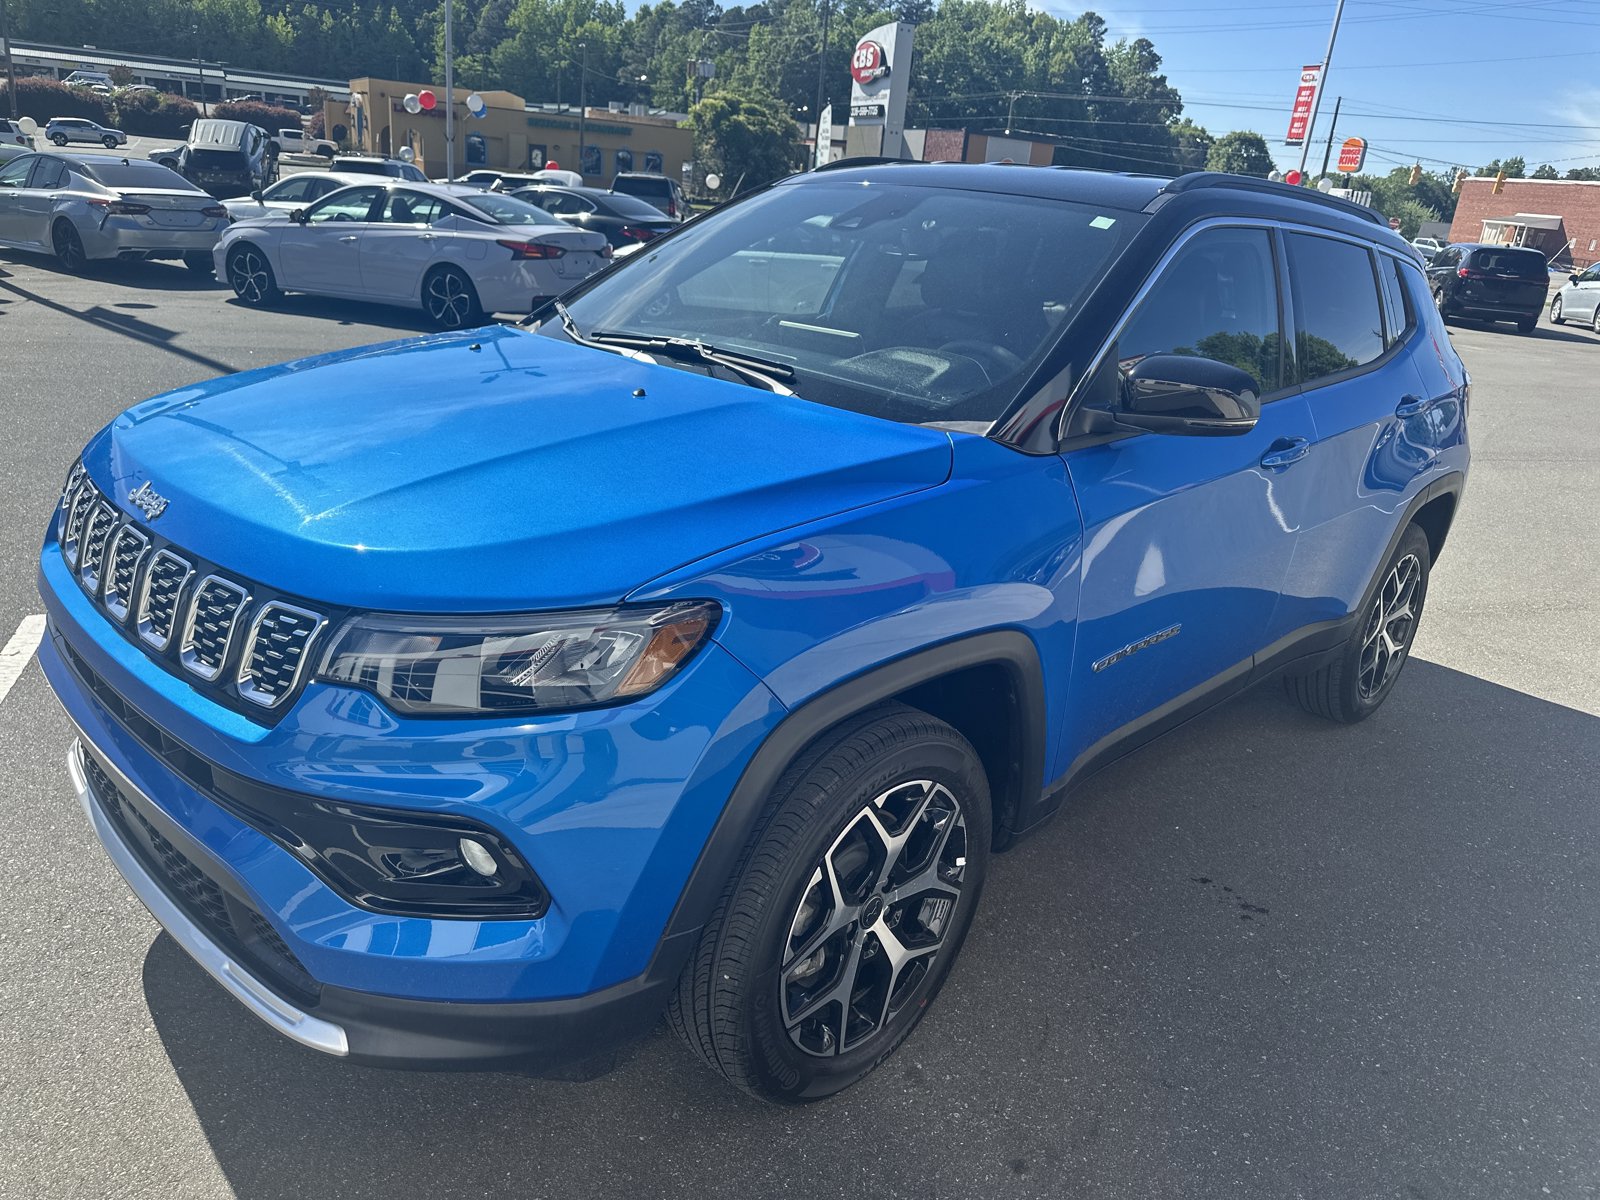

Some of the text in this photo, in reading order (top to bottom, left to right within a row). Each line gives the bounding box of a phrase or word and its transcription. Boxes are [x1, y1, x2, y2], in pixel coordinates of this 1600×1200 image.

[853, 47, 874, 69] CBS
[1338, 155, 1360, 166] KING
[128, 480, 170, 521] Jeep
